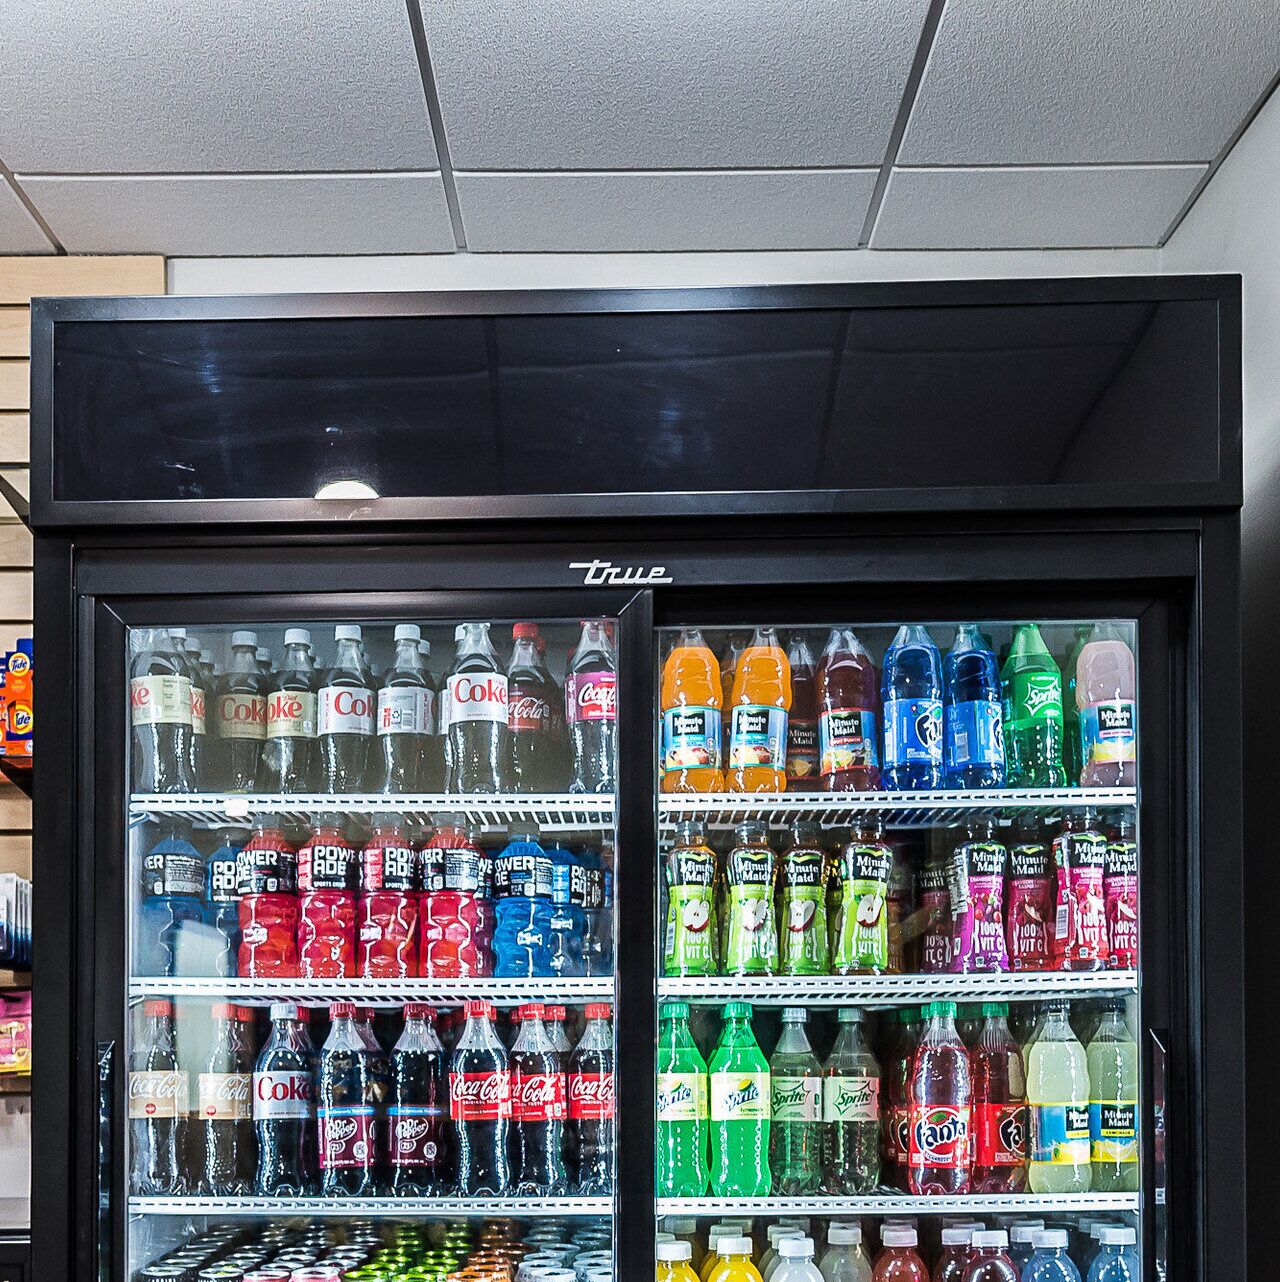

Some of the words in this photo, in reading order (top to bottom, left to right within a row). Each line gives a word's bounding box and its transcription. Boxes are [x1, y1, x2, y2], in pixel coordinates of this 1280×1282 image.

[11, 657, 28, 671] Tide
[1029, 687, 1061, 704] Sprite
[830, 719, 859, 729] Minute
[789, 729, 816, 738] Minute
[834, 727, 856, 736] Maid
[792, 737, 813, 745] Maid
[972, 851, 1006, 863] Minute
[1013, 855, 1048, 866] Minute
[314, 860, 347, 876] ADE
[1016, 864, 1044, 875] Maid
[788, 872, 814, 882] Maid
[980, 922, 1004, 936] 100%
[1020, 924, 1043, 937] 100%
[980, 937, 995, 950] VIT
[1020, 939, 1036, 951] VIT
[1114, 936, 1129, 949] VIT
[258, 1076, 310, 1101] Coke
[453, 1075, 510, 1101] Coca-Cola
[773, 1090, 806, 1106] Sprite
[838, 1090, 872, 1105] Sprite
[1104, 1110, 1133, 1121] Minute
[397, 1120, 427, 1139] Pepper
[1109, 1118, 1130, 1128] Maid
[915, 1116, 966, 1151] Fanta
